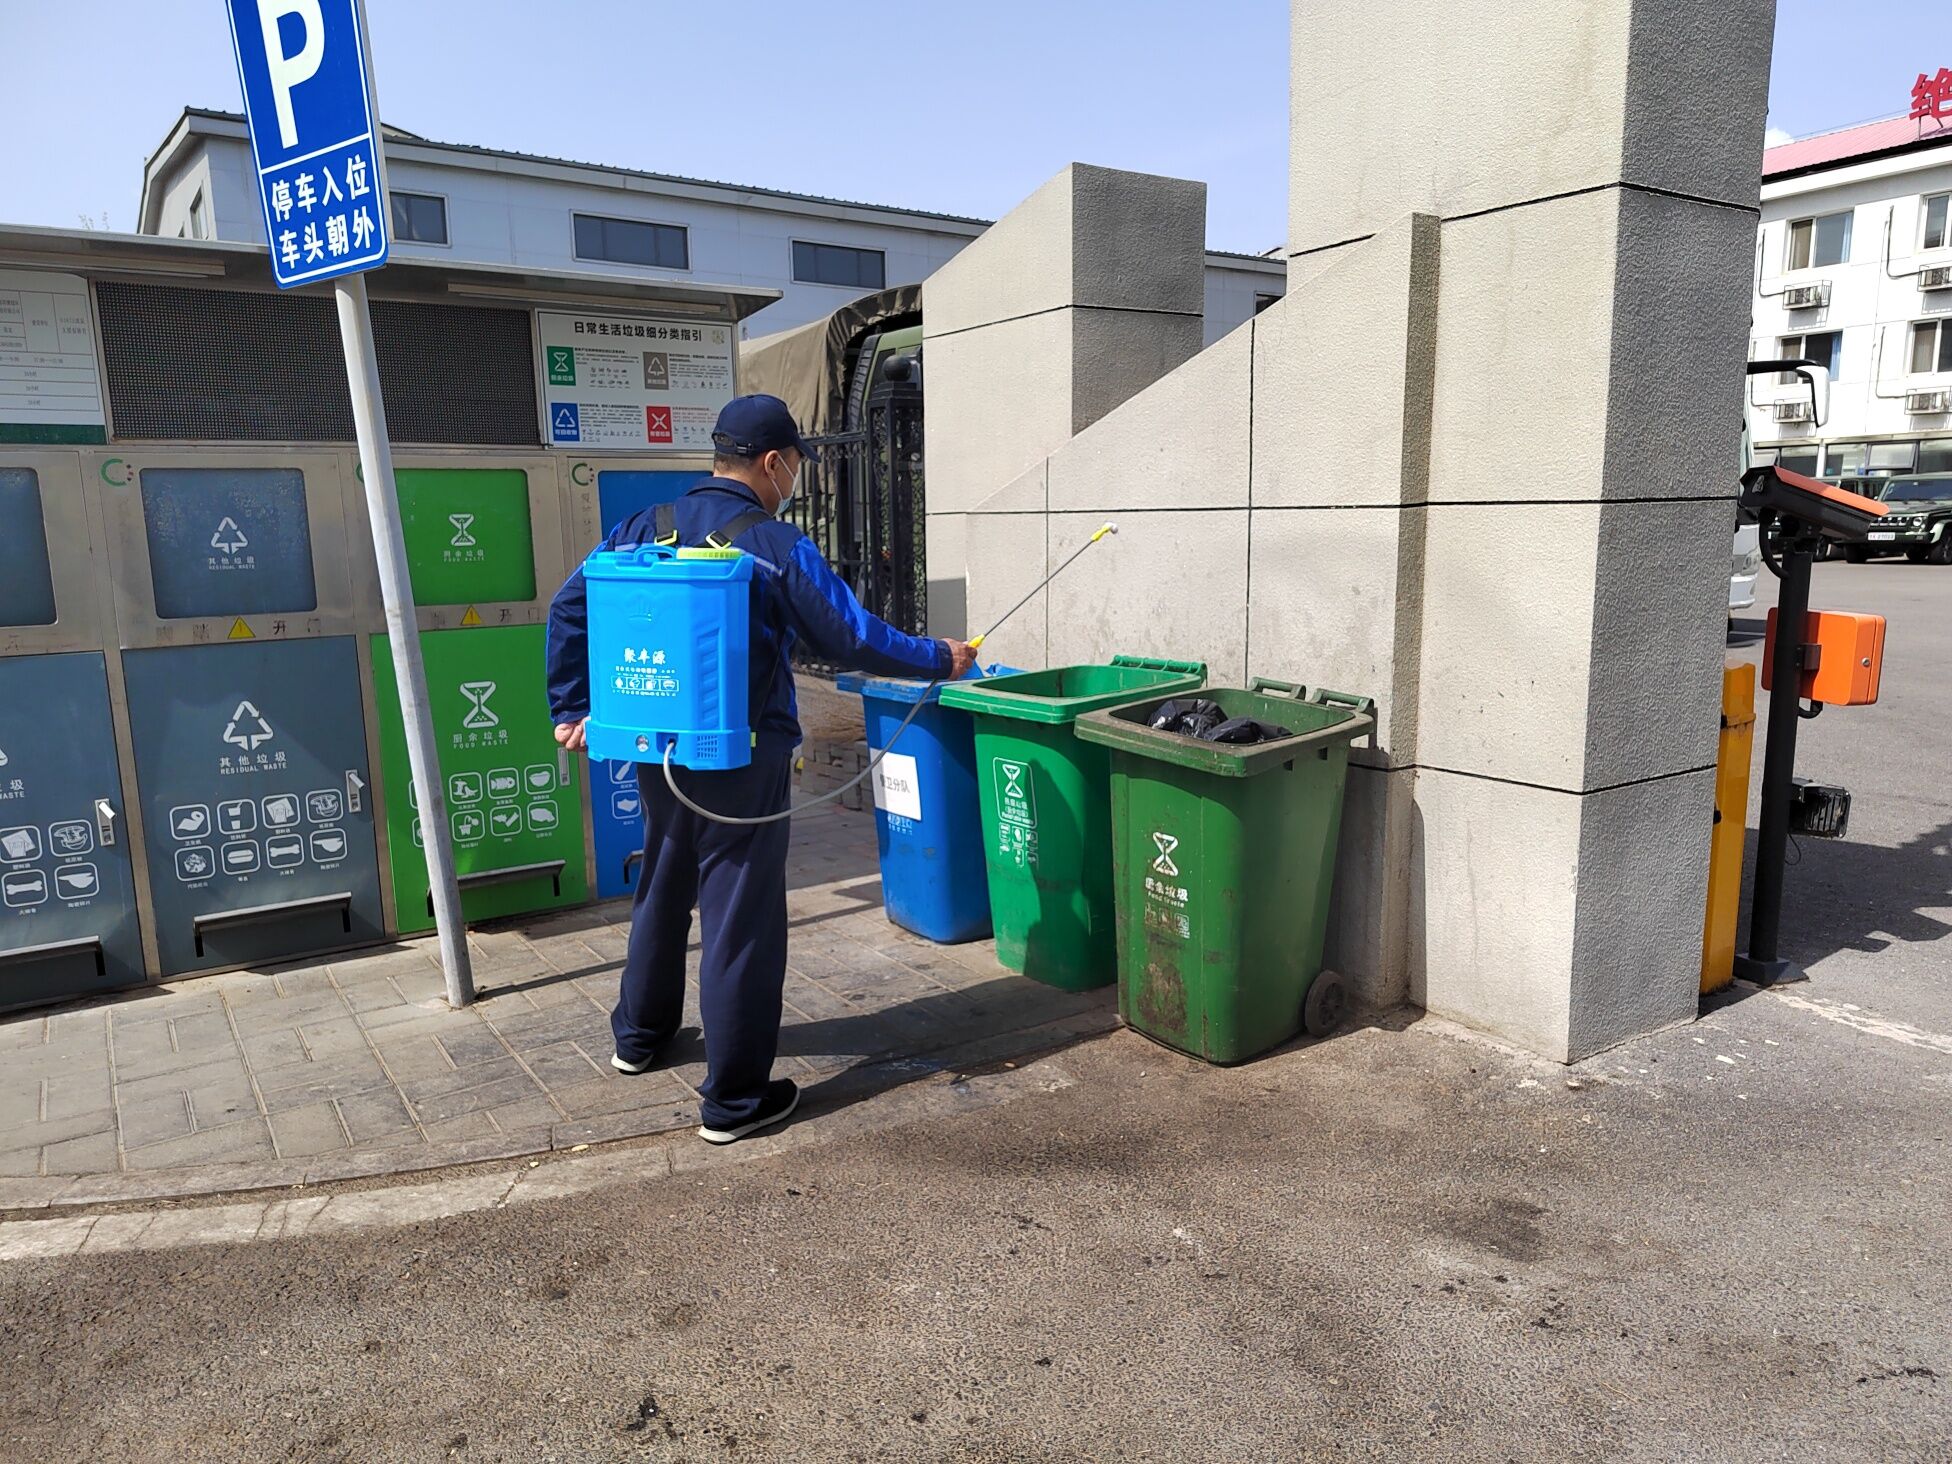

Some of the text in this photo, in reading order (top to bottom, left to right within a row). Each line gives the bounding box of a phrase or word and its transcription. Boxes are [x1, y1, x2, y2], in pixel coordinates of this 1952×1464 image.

[256, 0, 325, 149] P
[1909, 67, 1952, 120] 绝
[271, 154, 370, 222] 停车入位
[279, 205, 375, 269] 车头朝外
[574, 321, 702, 342] 日常生活垃圾细分类指引
[453, 729, 508, 744] 厨余垃圾
[219, 751, 287, 768] 其他垃圾
[220, 762, 287, 775] RESIDUAL WASTE
